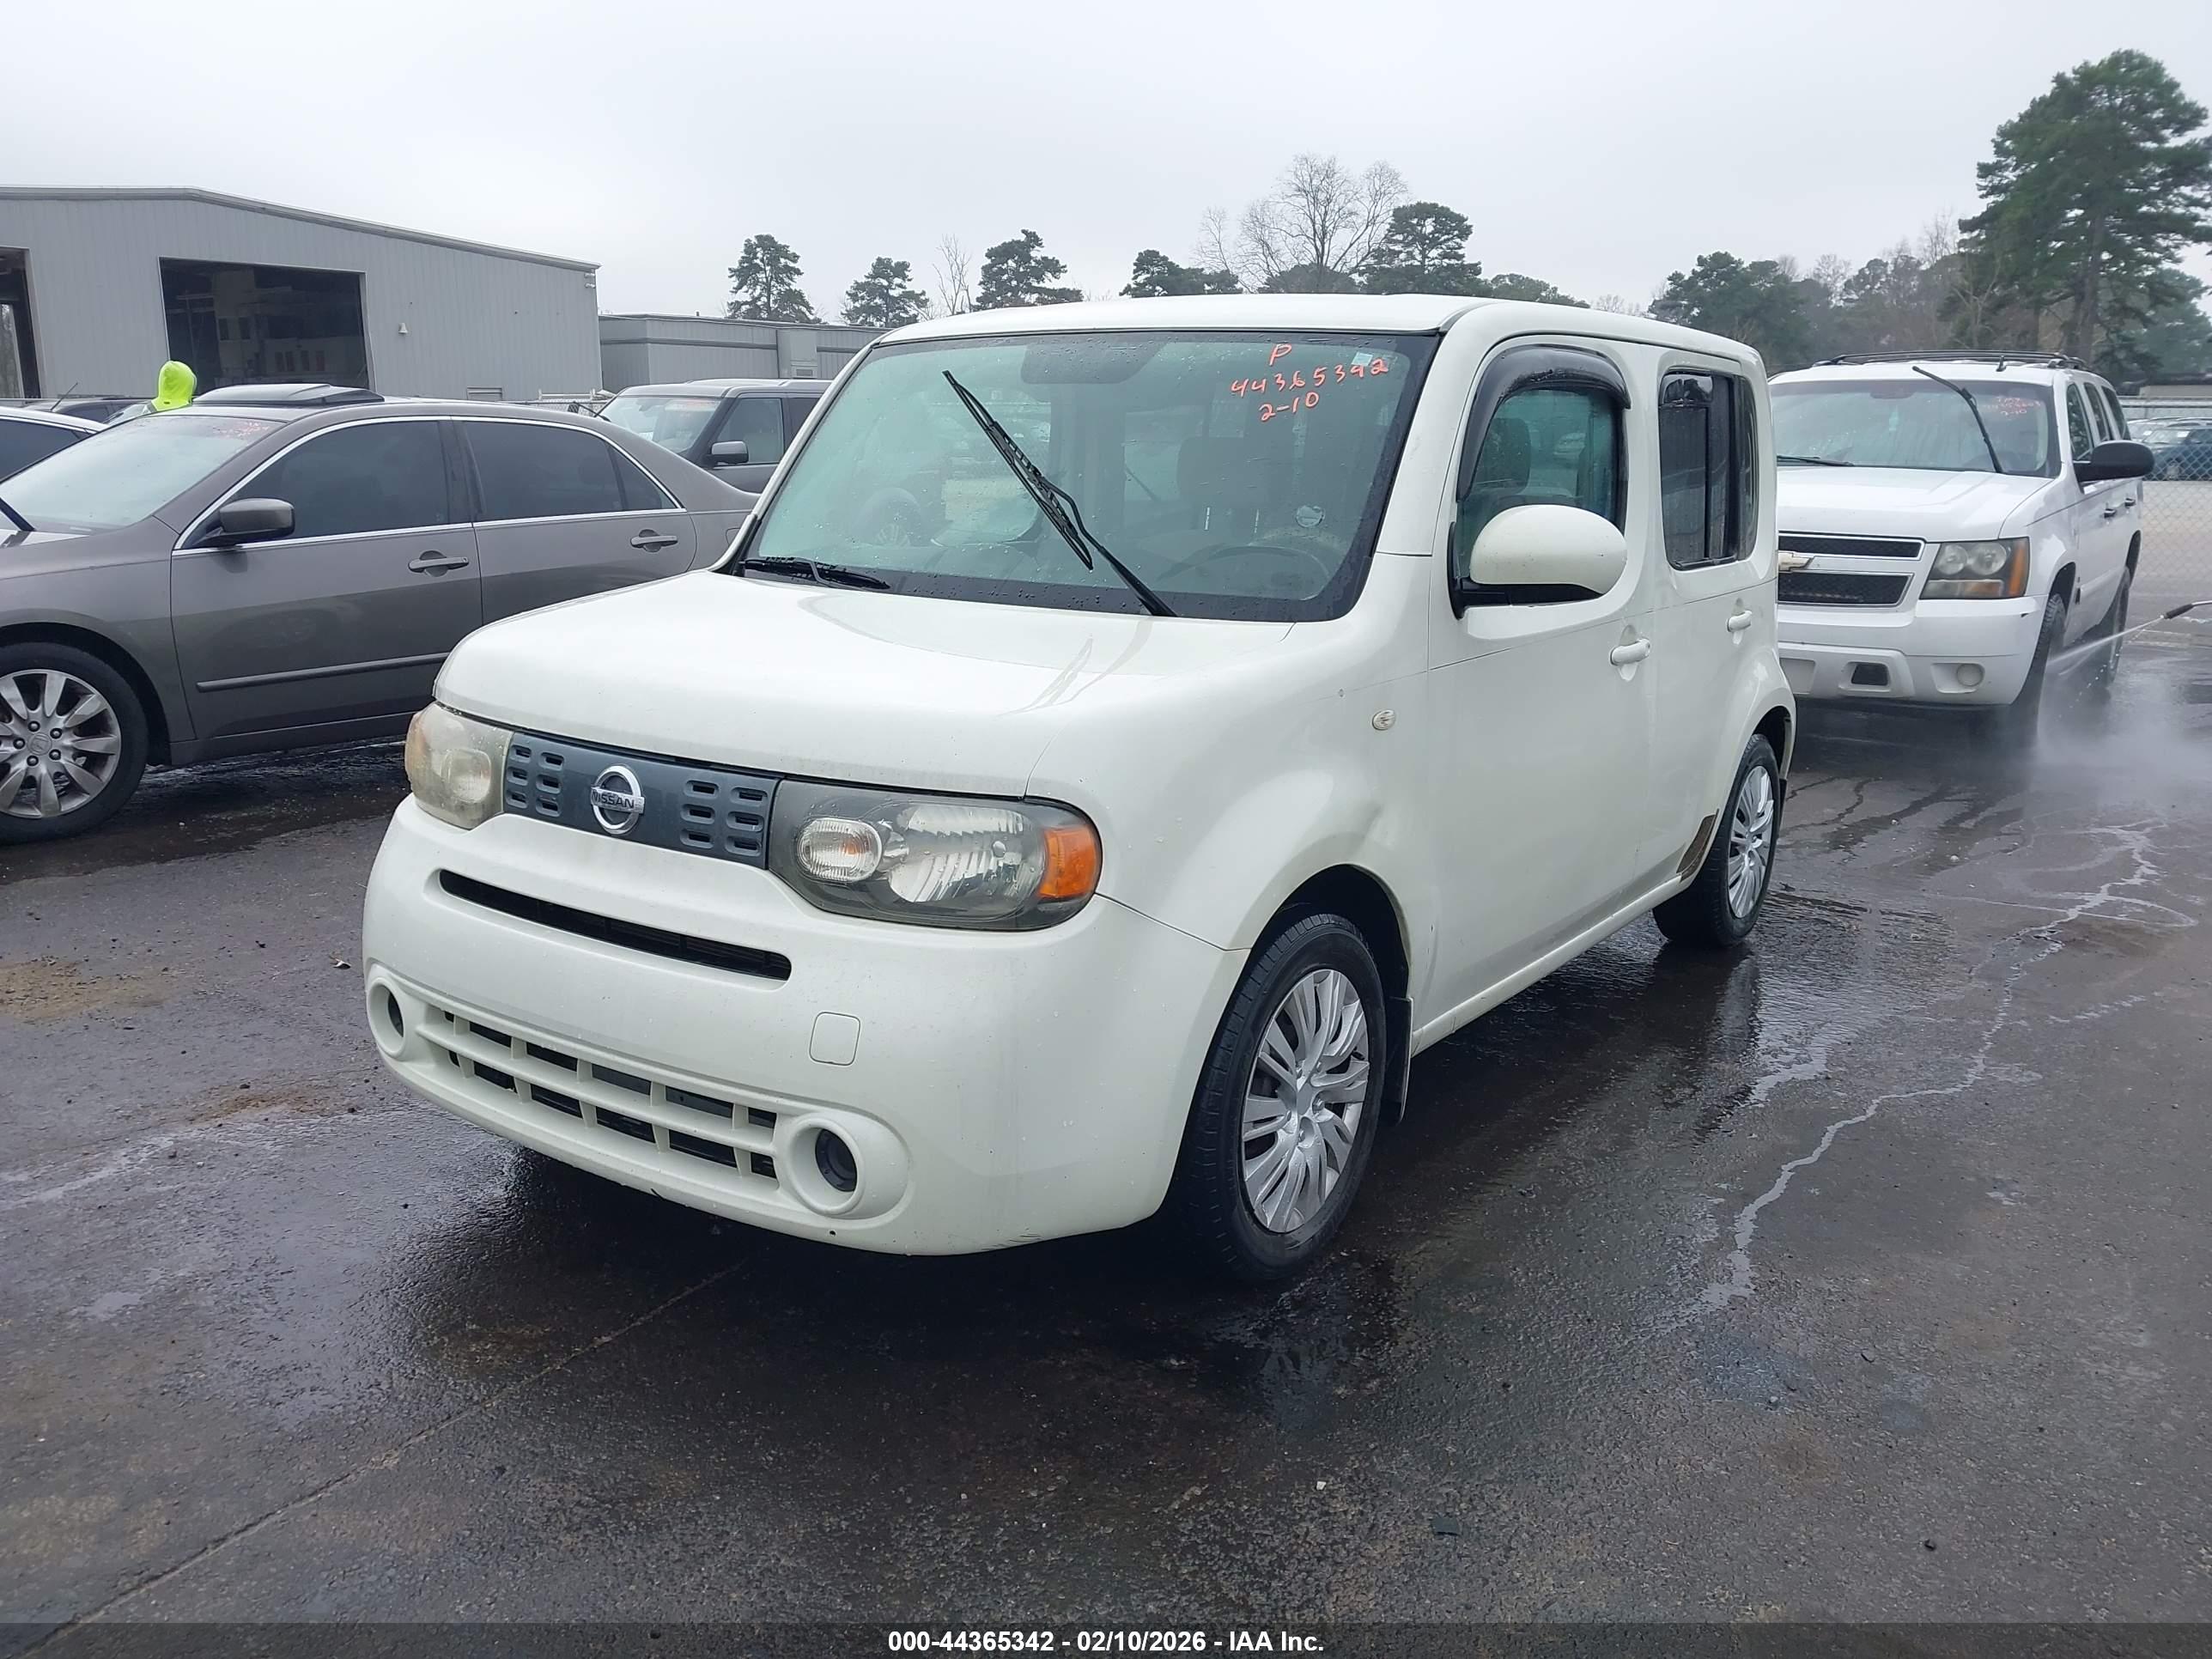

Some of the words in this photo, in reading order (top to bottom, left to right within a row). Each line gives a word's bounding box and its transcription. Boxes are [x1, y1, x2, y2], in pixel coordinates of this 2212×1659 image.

[1268, 343, 1292, 367] P
[1258, 391, 1320, 422] 2-10
[592, 790, 635, 809] NISSAN
